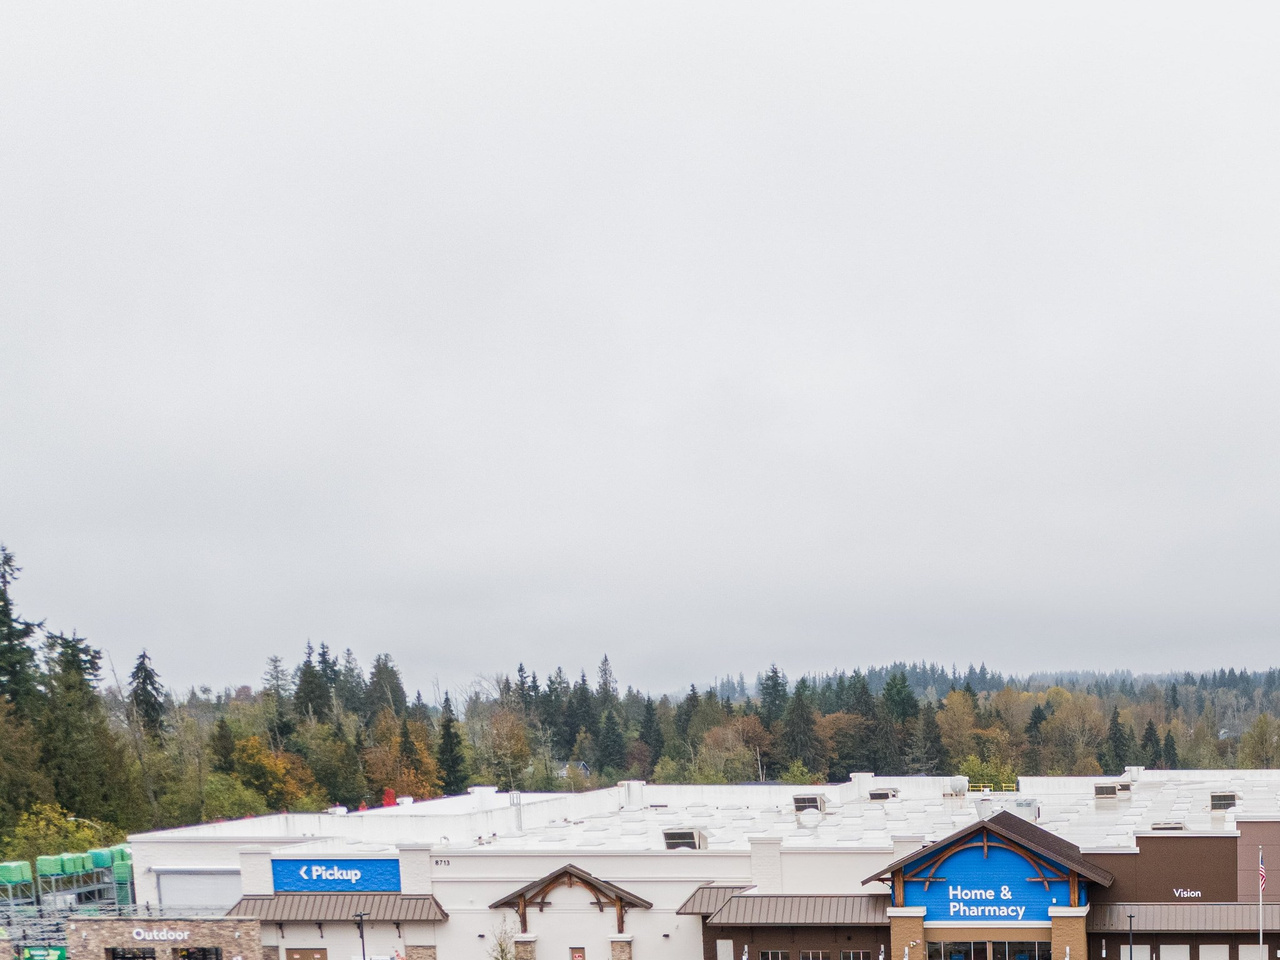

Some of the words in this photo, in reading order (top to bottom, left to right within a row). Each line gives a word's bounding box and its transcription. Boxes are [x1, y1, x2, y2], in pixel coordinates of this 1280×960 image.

[312, 866, 361, 883] Pickup
[949, 886, 995, 899] Home
[1000, 885, 1012, 899] &
[1173, 889, 1201, 897] Vision
[949, 902, 1025, 920] Pharmacy
[132, 928, 190, 940] Outdoor
